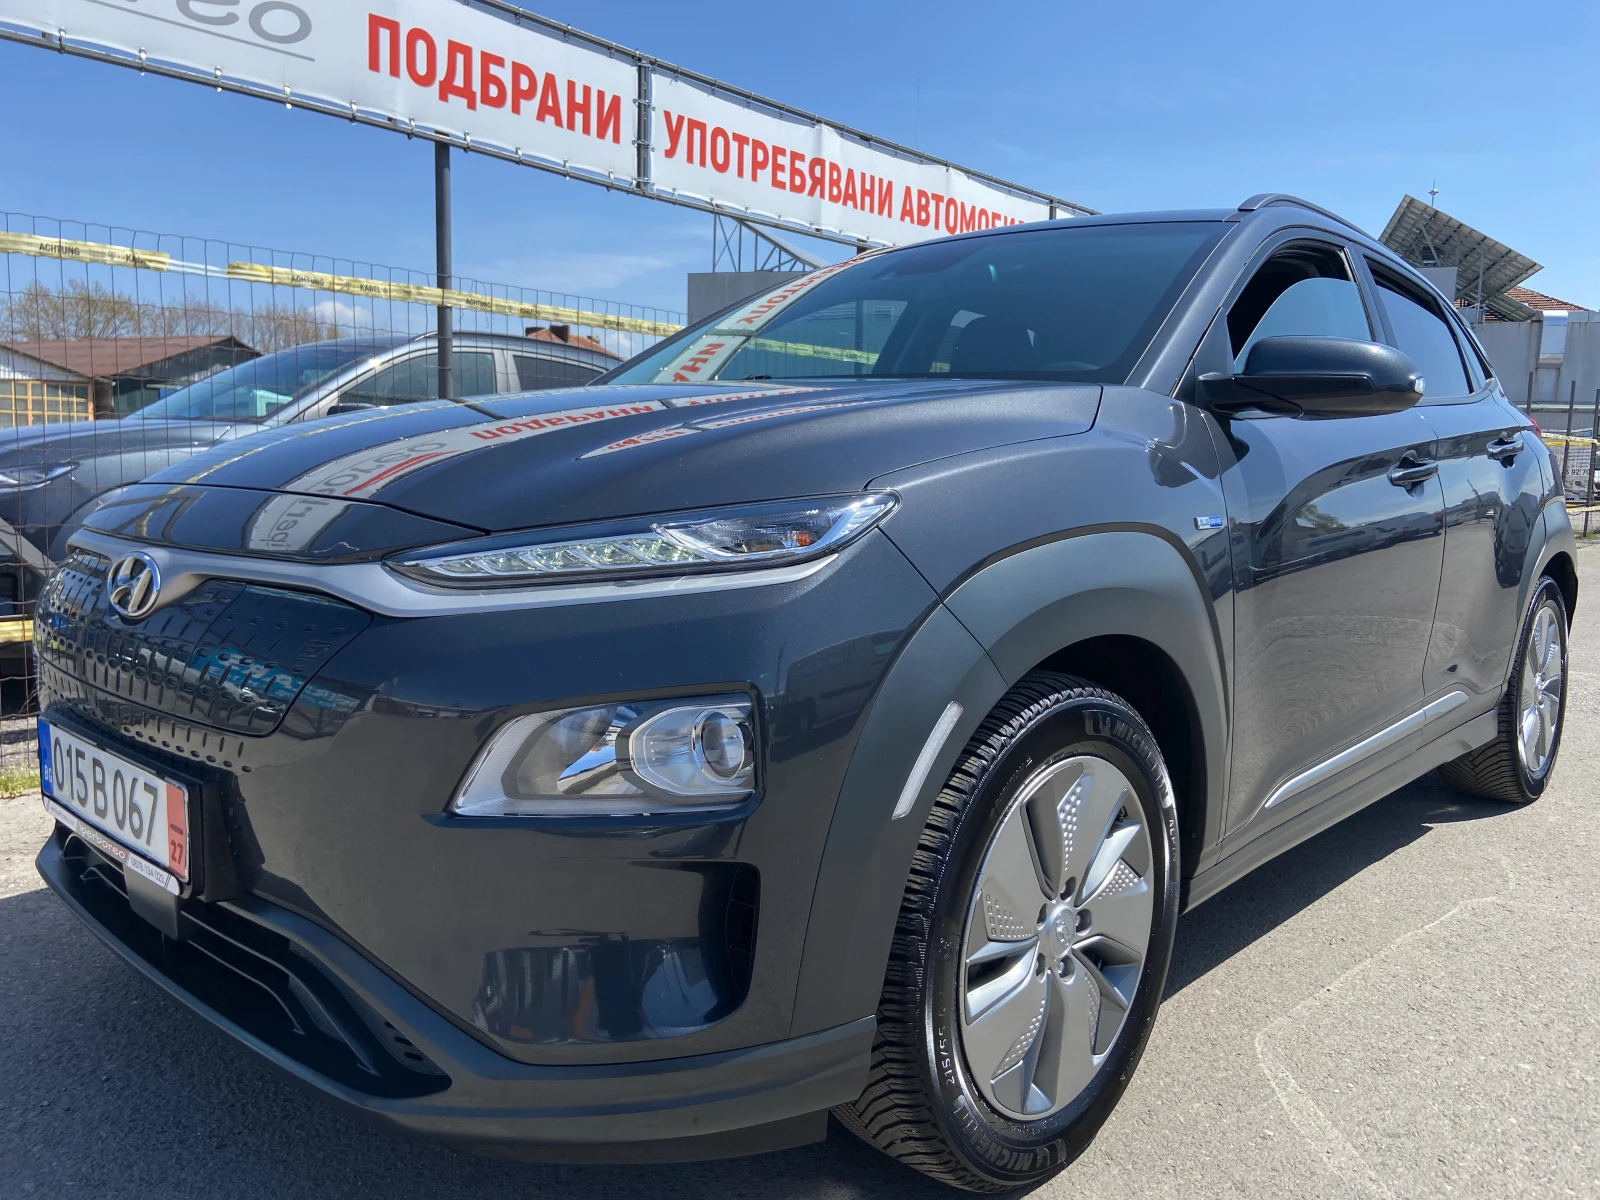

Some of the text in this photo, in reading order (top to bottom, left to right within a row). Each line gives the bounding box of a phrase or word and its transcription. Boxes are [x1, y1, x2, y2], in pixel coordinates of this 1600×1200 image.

[368, 14, 622, 145] ПОДБРАНИ
[662, 109, 893, 219] УПОТРЕБЯВАНИ
[39, 242, 80, 256] ACHTUNG
[360, 284, 381, 293] KABEL
[1112, 717, 1170, 800] MICHELIN
[170, 839, 184, 865] 27
[938, 1026, 955, 1086] 215/55
